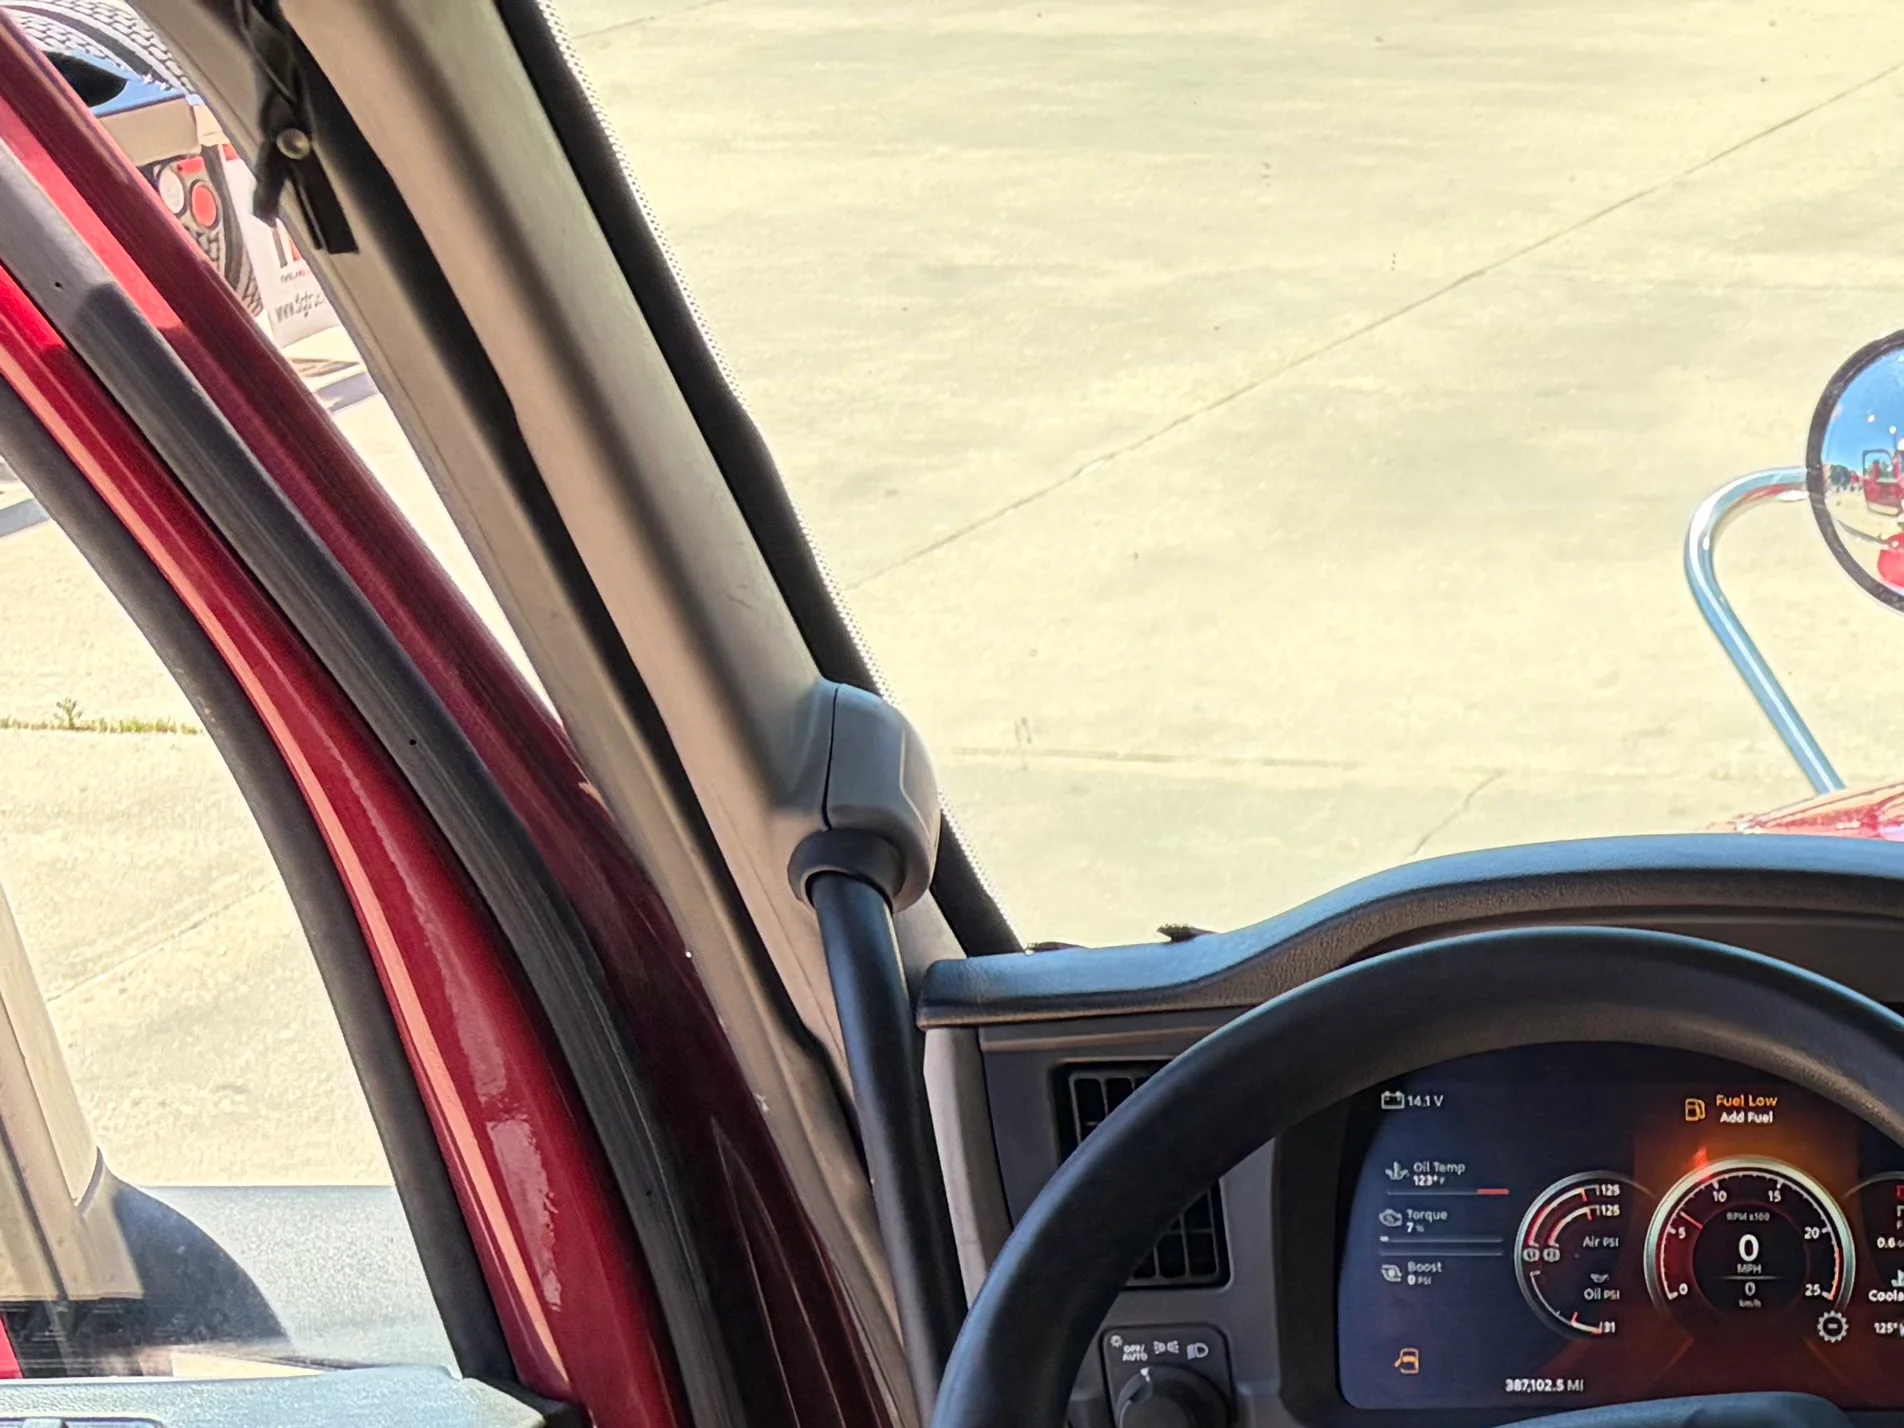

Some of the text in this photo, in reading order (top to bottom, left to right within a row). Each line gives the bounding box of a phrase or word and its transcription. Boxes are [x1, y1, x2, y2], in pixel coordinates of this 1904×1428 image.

[1433, 1095, 1444, 1107] V
[1716, 1094, 1778, 1107] Fuel Low
[1720, 1111, 1773, 1123] Add Fuel
[1413, 1162, 1466, 1176] Oil Temp
[1601, 1184, 1620, 1196] 125
[1713, 1191, 1727, 1202] 10
[1768, 1191, 1781, 1201] 15
[1601, 1204, 1620, 1216] 125
[1406, 1209, 1447, 1223] Torque
[1726, 1212, 1748, 1221] RPM
[1406, 1223, 1414, 1233] 7
[1679, 1227, 1686, 1239] 5
[1804, 1228, 1819, 1239] 20
[1583, 1235, 1620, 1248] Air PSI
[1738, 1234, 1759, 1261] 0
[1407, 1262, 1442, 1273] Boost
[1737, 1264, 1762, 1275] MPH
[1407, 1275, 1431, 1286] 0 PSI
[1584, 1288, 1620, 1300] Oil PSI
[1679, 1284, 1688, 1295] 0
[1745, 1282, 1756, 1295] 0
[1805, 1284, 1820, 1295] 25
[1739, 1299, 1762, 1309] km/h
[1122, 1352, 1148, 1362] AUTO
[1567, 1380, 1584, 1391] MI
